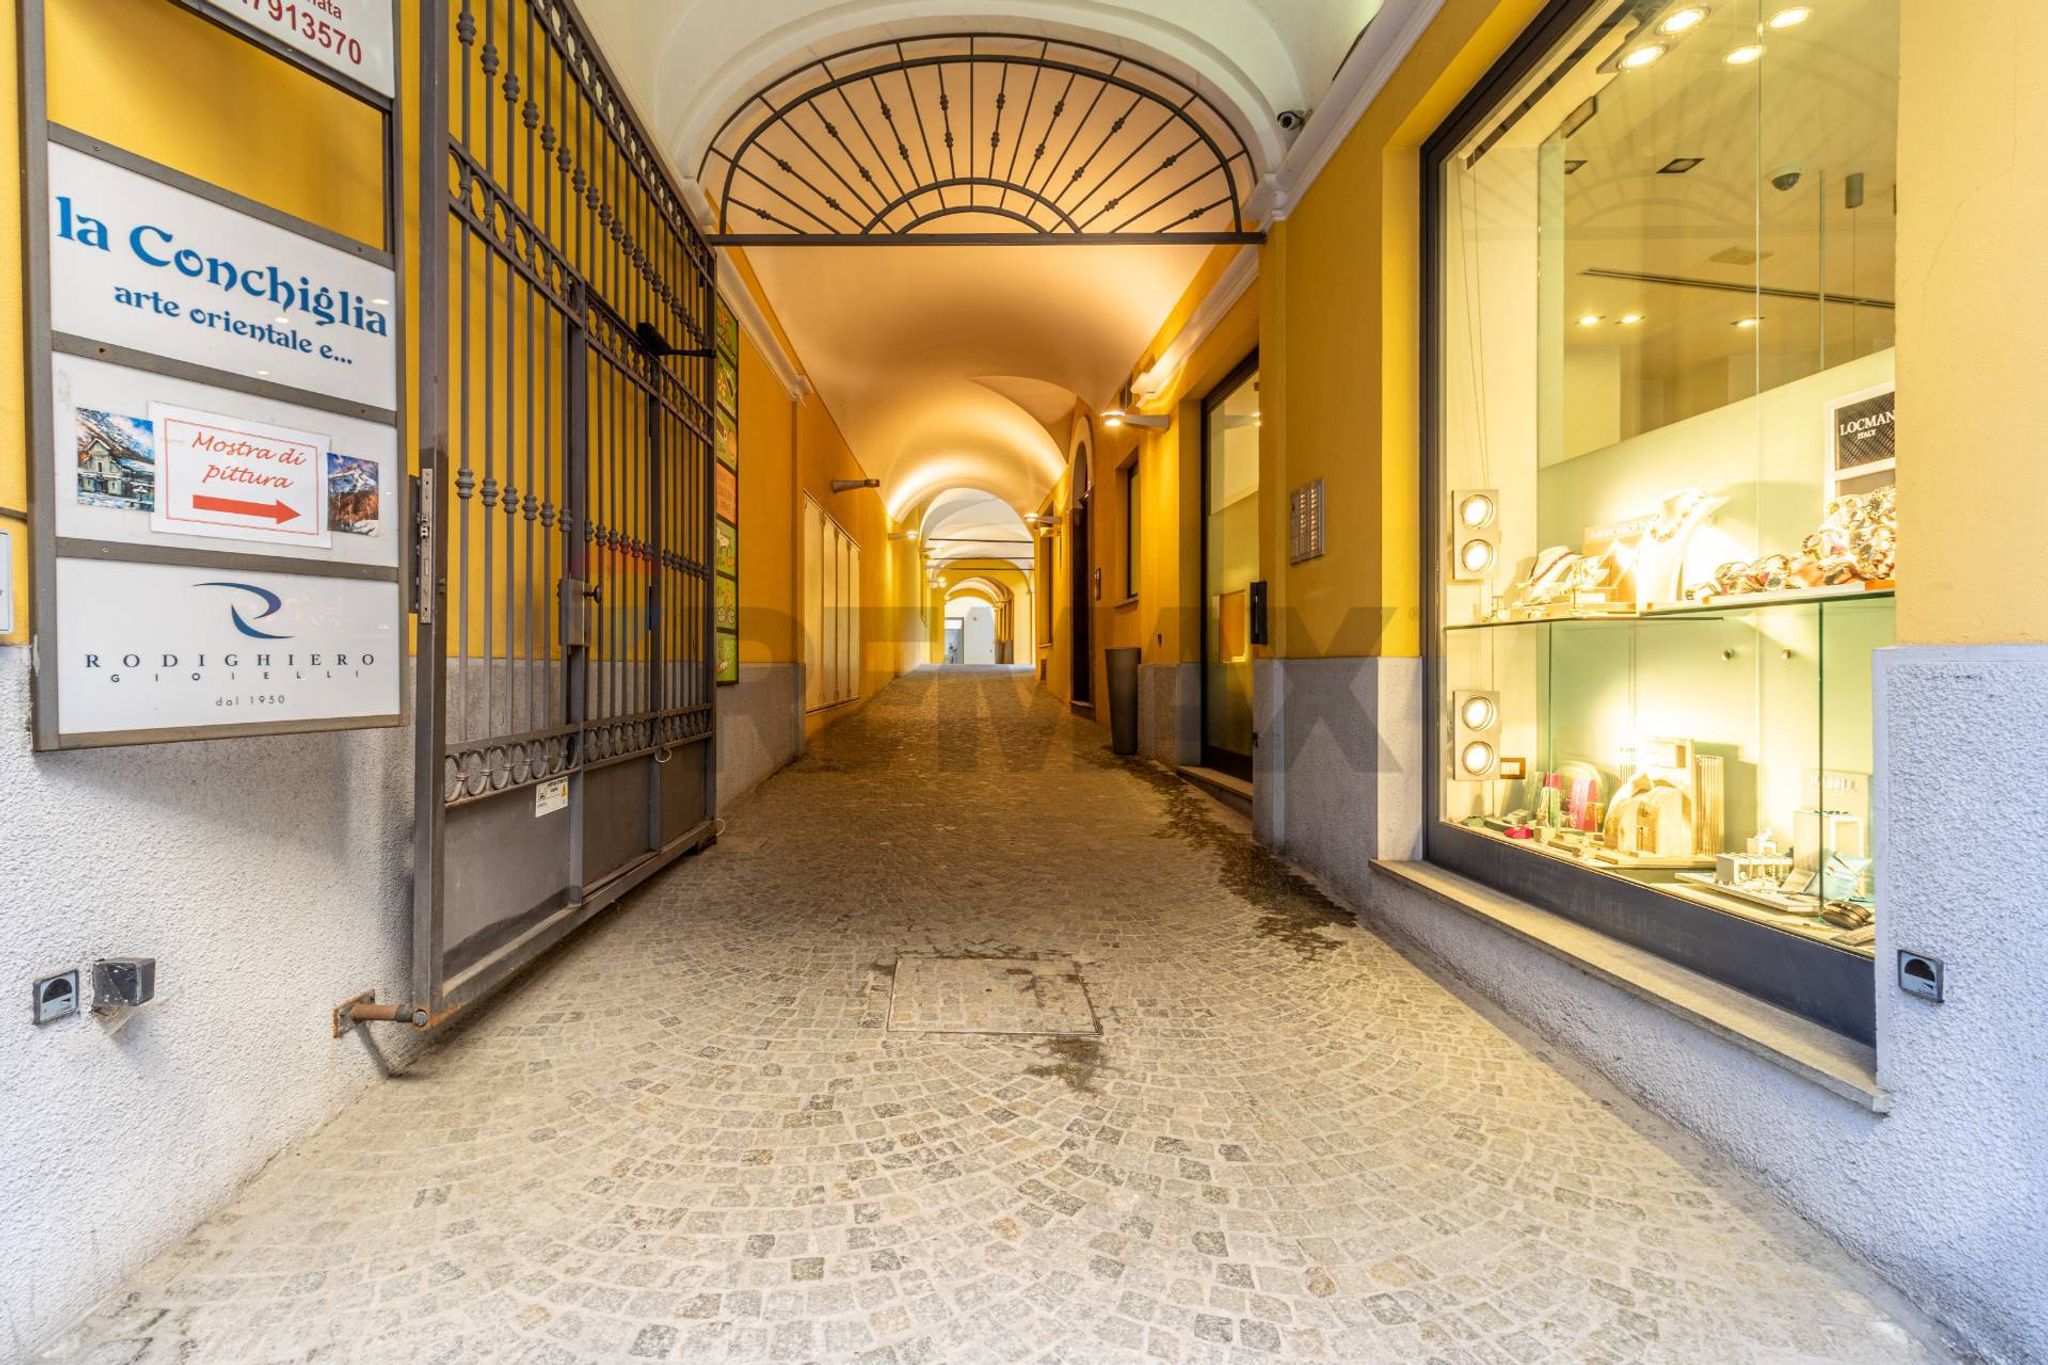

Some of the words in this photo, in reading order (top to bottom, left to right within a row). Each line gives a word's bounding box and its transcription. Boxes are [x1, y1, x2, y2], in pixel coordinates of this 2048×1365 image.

[55, 196, 110, 252] la
[129, 224, 388, 337] Conchiglia
[114, 285, 181, 318] arte
[190, 308, 313, 353] orientale
[1840, 410, 1895, 436] LOCMAN
[1857, 428, 1876, 440] ITALY
[191, 431, 275, 464] Mostra
[279, 447, 307, 467] di
[202, 462, 293, 490] pittura
[86, 654, 375, 667] RODIGHIERO
[111, 670, 359, 683] GIOIELLI
[215, 697, 239, 707] dal
[249, 694, 286, 705] 1950
